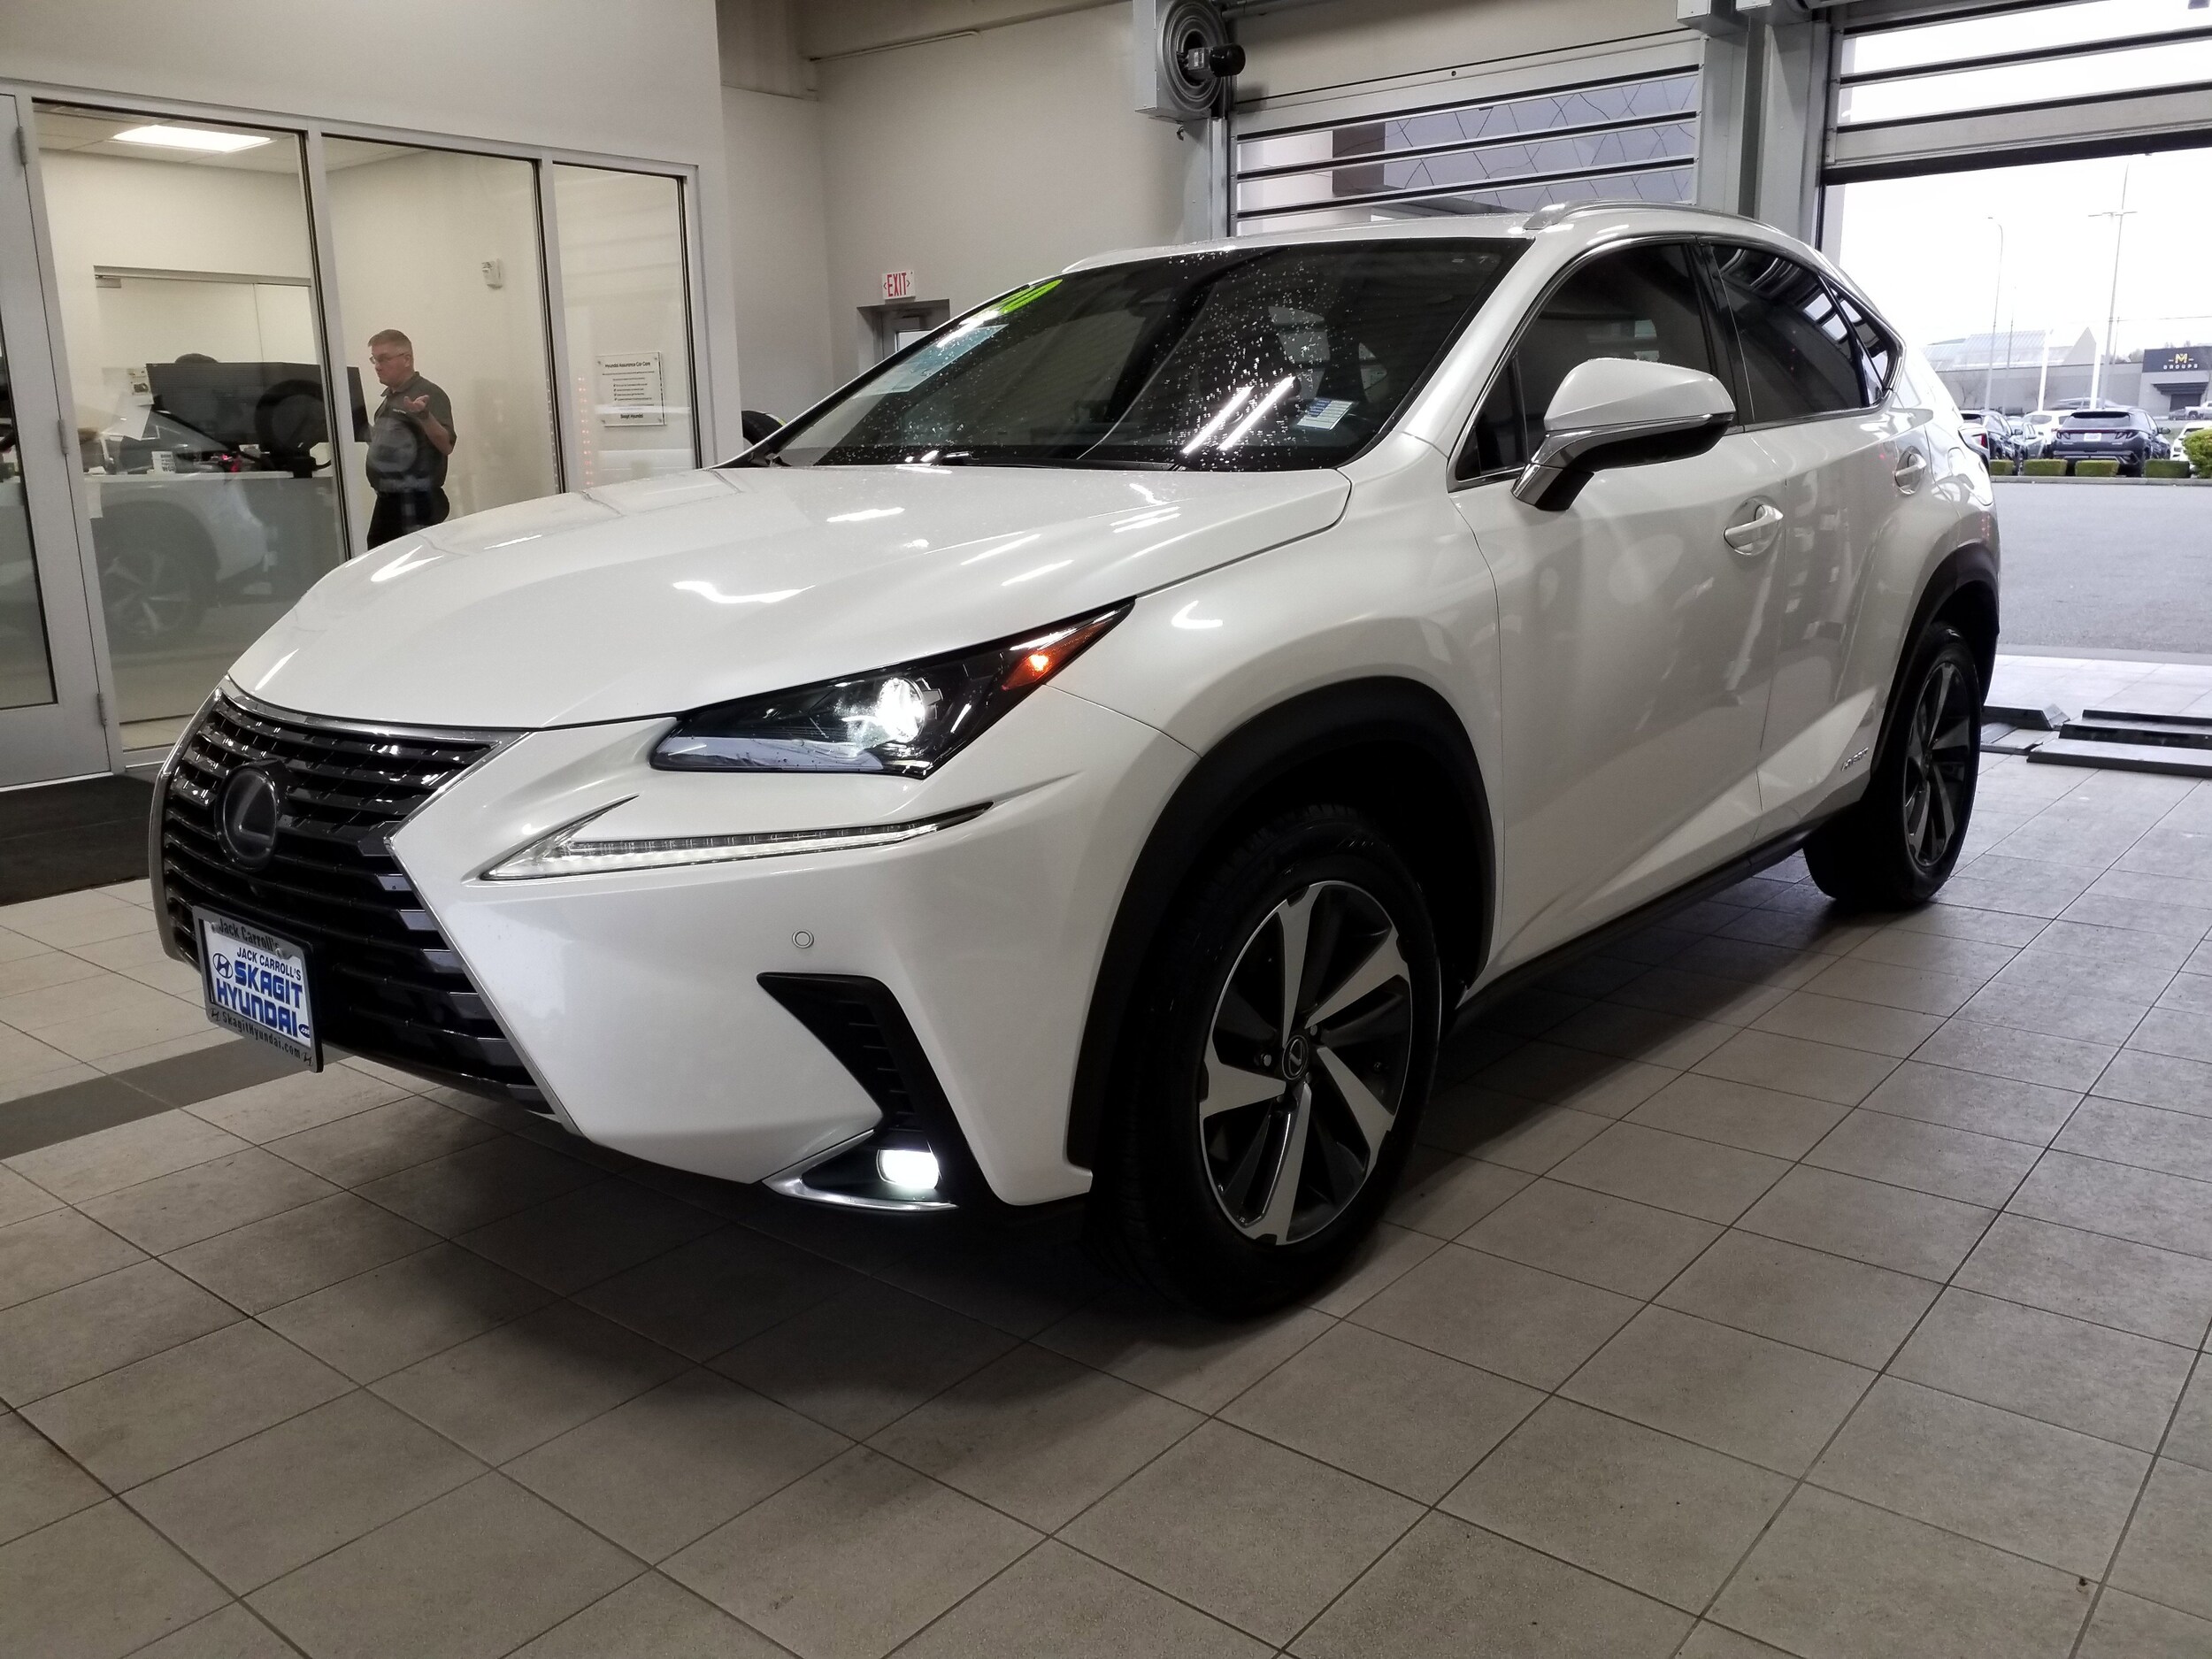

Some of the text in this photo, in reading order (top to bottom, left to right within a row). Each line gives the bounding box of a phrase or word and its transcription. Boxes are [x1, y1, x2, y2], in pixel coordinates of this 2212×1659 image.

[887, 272, 907, 297] EXIT
[219, 917, 240, 939] Jack
[234, 960, 303, 1009] SKAGIT
[236, 947, 302, 981] JACK CARROLL'S
[216, 978, 299, 1038] HYUNDAI
[222, 1010, 301, 1059] SkagitHyundai.com
